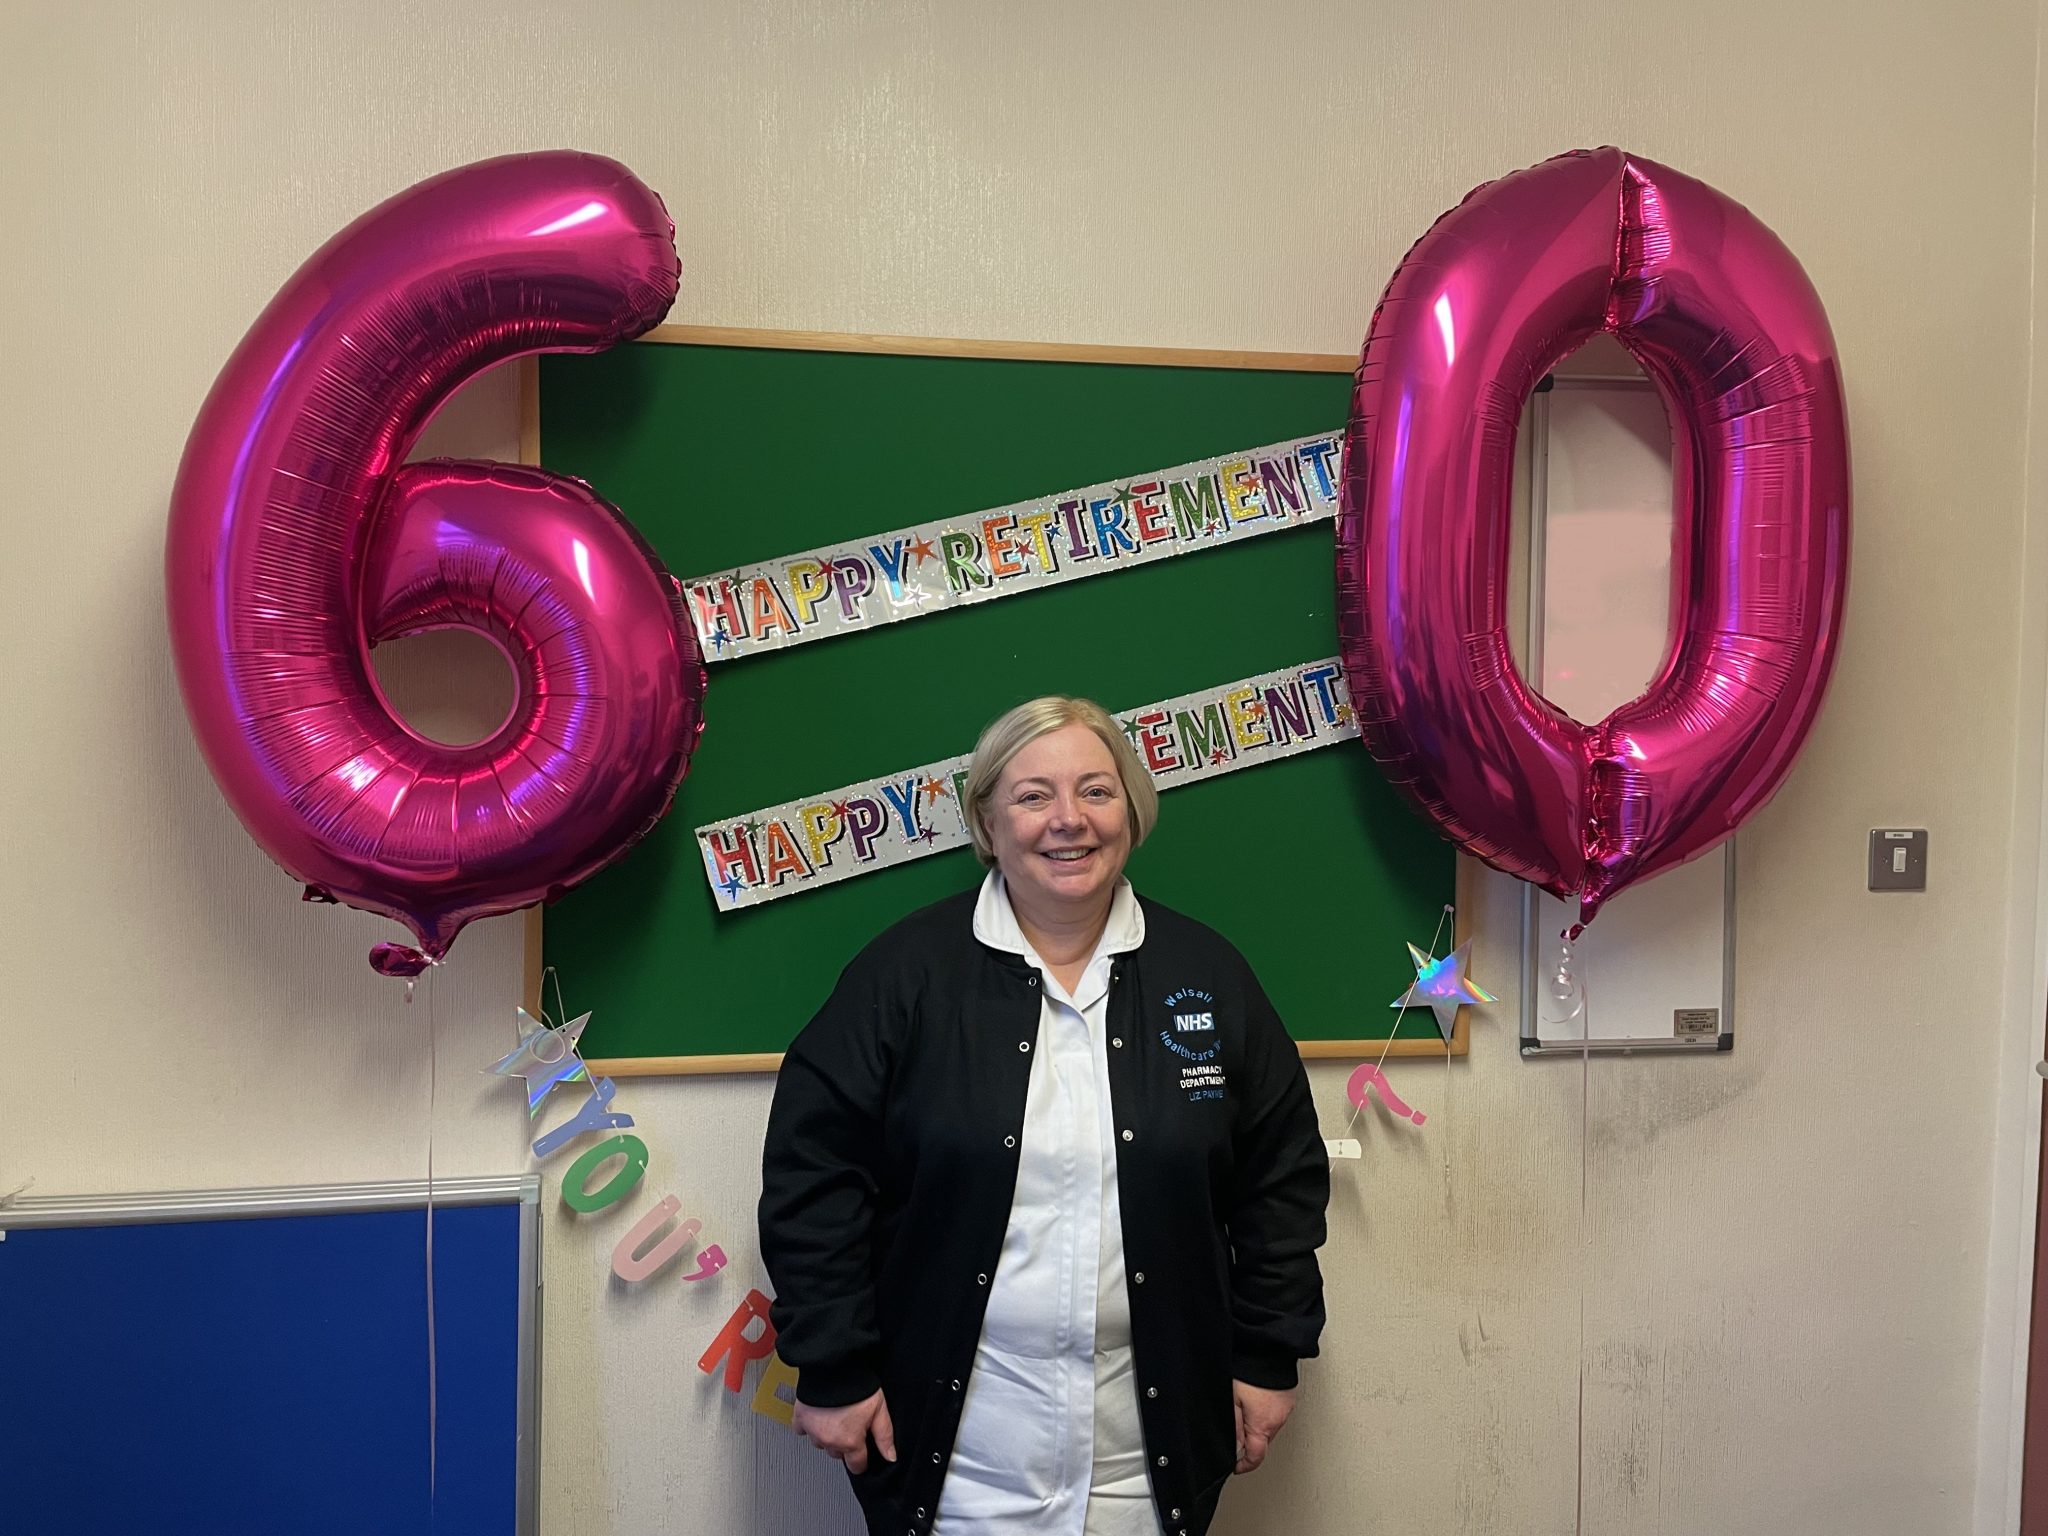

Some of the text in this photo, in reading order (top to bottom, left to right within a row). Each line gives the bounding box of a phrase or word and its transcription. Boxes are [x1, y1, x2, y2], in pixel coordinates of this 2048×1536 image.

[693, 440, 1340, 640] HAPPY RETIREMENT
[709, 777, 922, 887] HAPPY
[1164, 987, 1213, 1007] Walsall
[1176, 1012, 1213, 1031] NHS
[1160, 1030, 1215, 1061] Healthcare
[1181, 1065, 1222, 1078] PHARMACY
